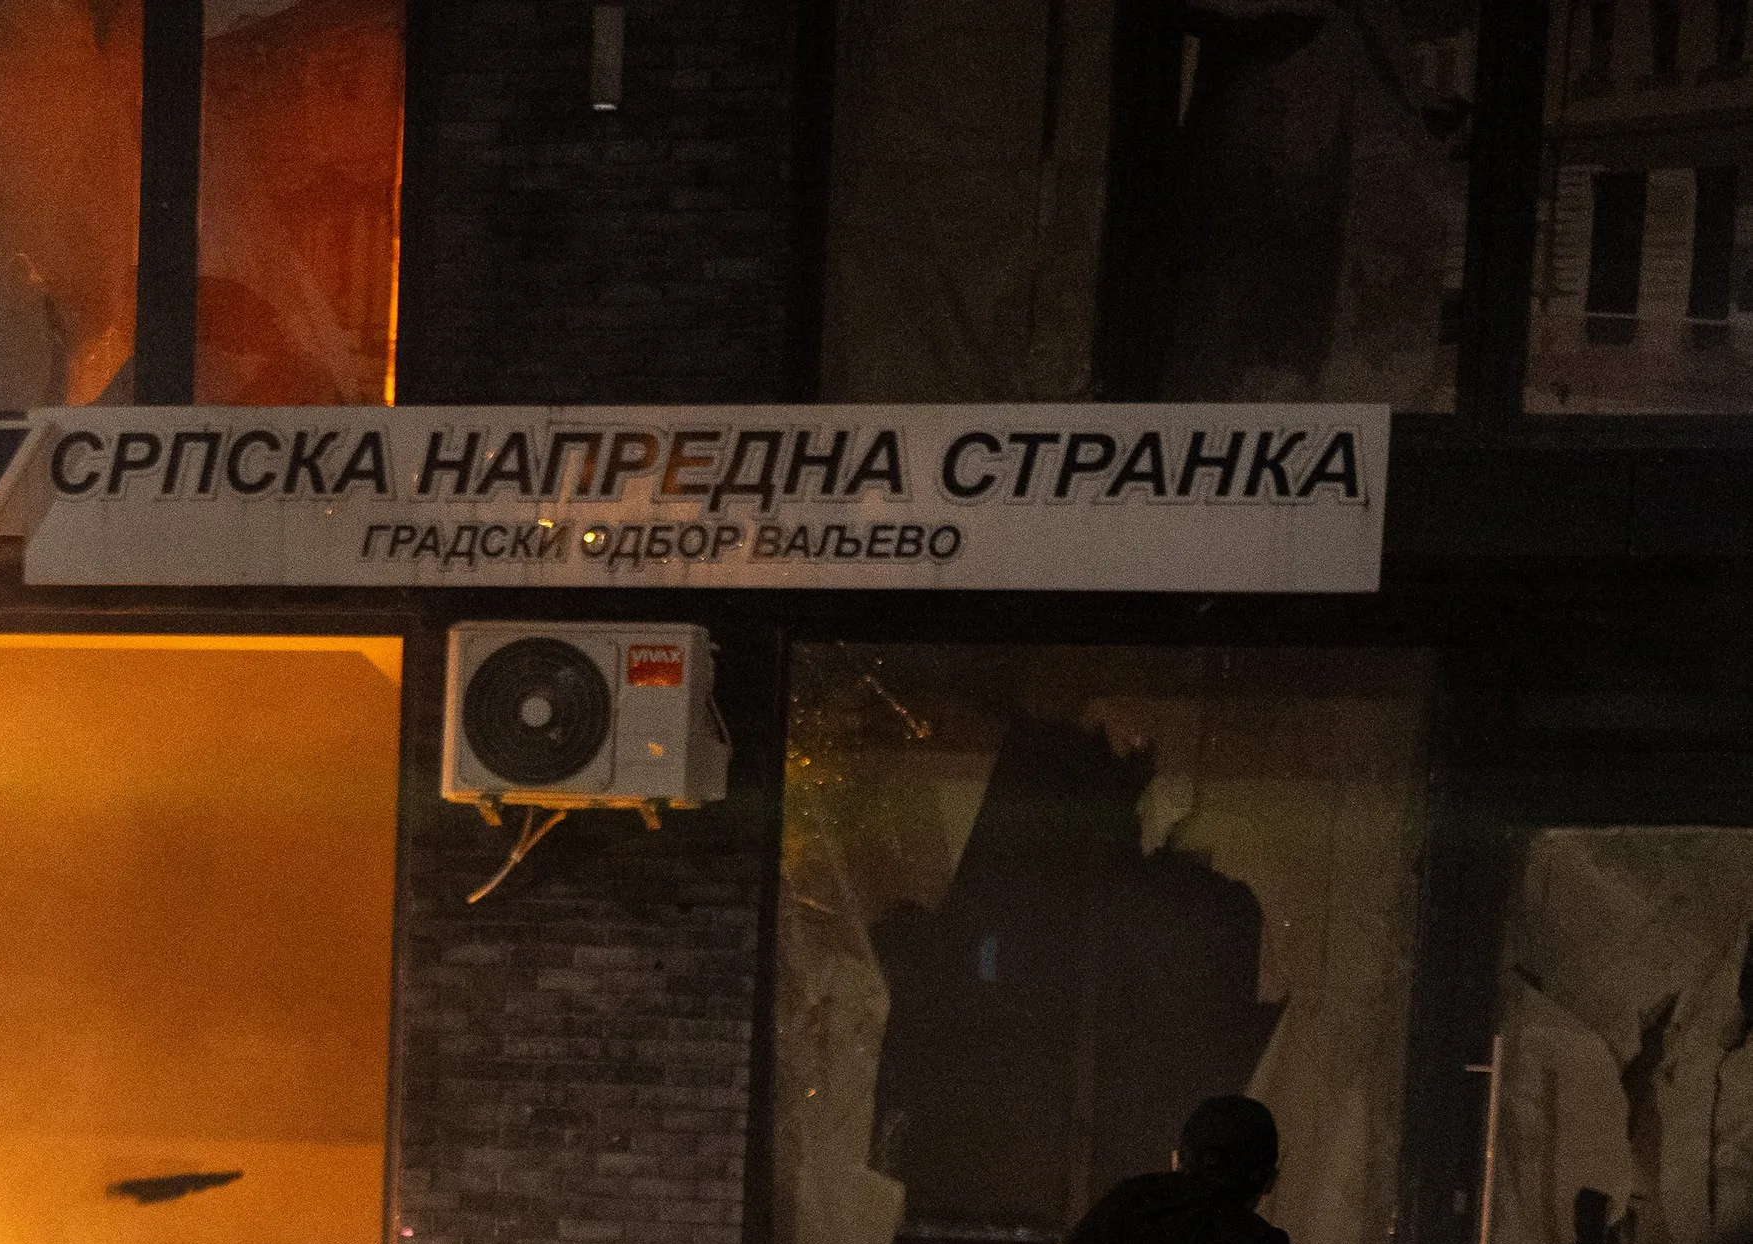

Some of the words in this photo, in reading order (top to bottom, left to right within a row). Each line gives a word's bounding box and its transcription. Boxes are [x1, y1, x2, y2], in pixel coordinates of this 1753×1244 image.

[50, 429, 388, 496] СРПСКА
[417, 429, 905, 514] НАПРЕДНА
[942, 430, 1362, 499] СТРАНКА
[361, 524, 566, 568] ГРАДСКИ
[582, 524, 741, 570] ОДБОР
[753, 523, 962, 560] ВАЉЕВО
